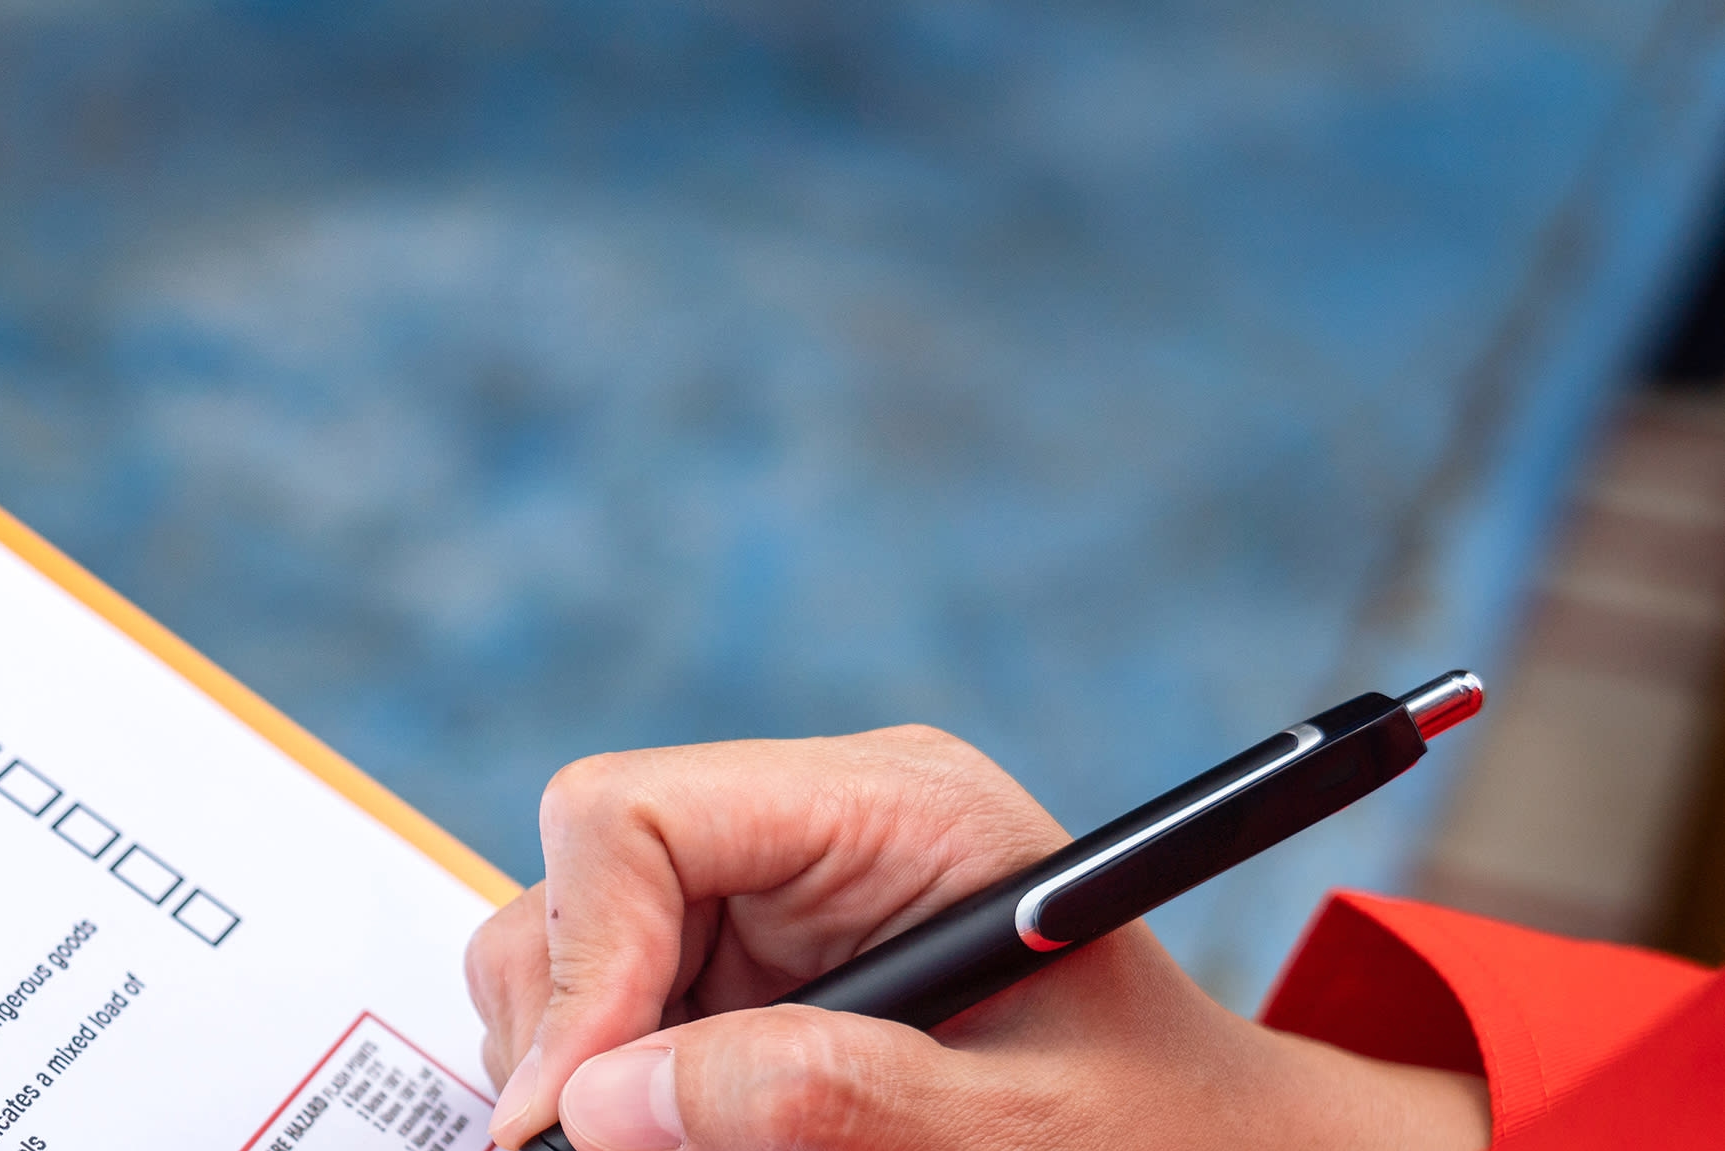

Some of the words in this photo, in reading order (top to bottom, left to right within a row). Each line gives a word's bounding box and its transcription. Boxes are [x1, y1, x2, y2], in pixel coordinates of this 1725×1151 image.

[47, 919, 98, 971] goods
[36, 1072, 54, 1087] a
[46, 1023, 98, 1075] mixed
[87, 991, 129, 1030] load
[123, 972, 145, 996] of
[284, 1096, 329, 1142] HAZARD
[345, 1040, 379, 1074] POINTS
